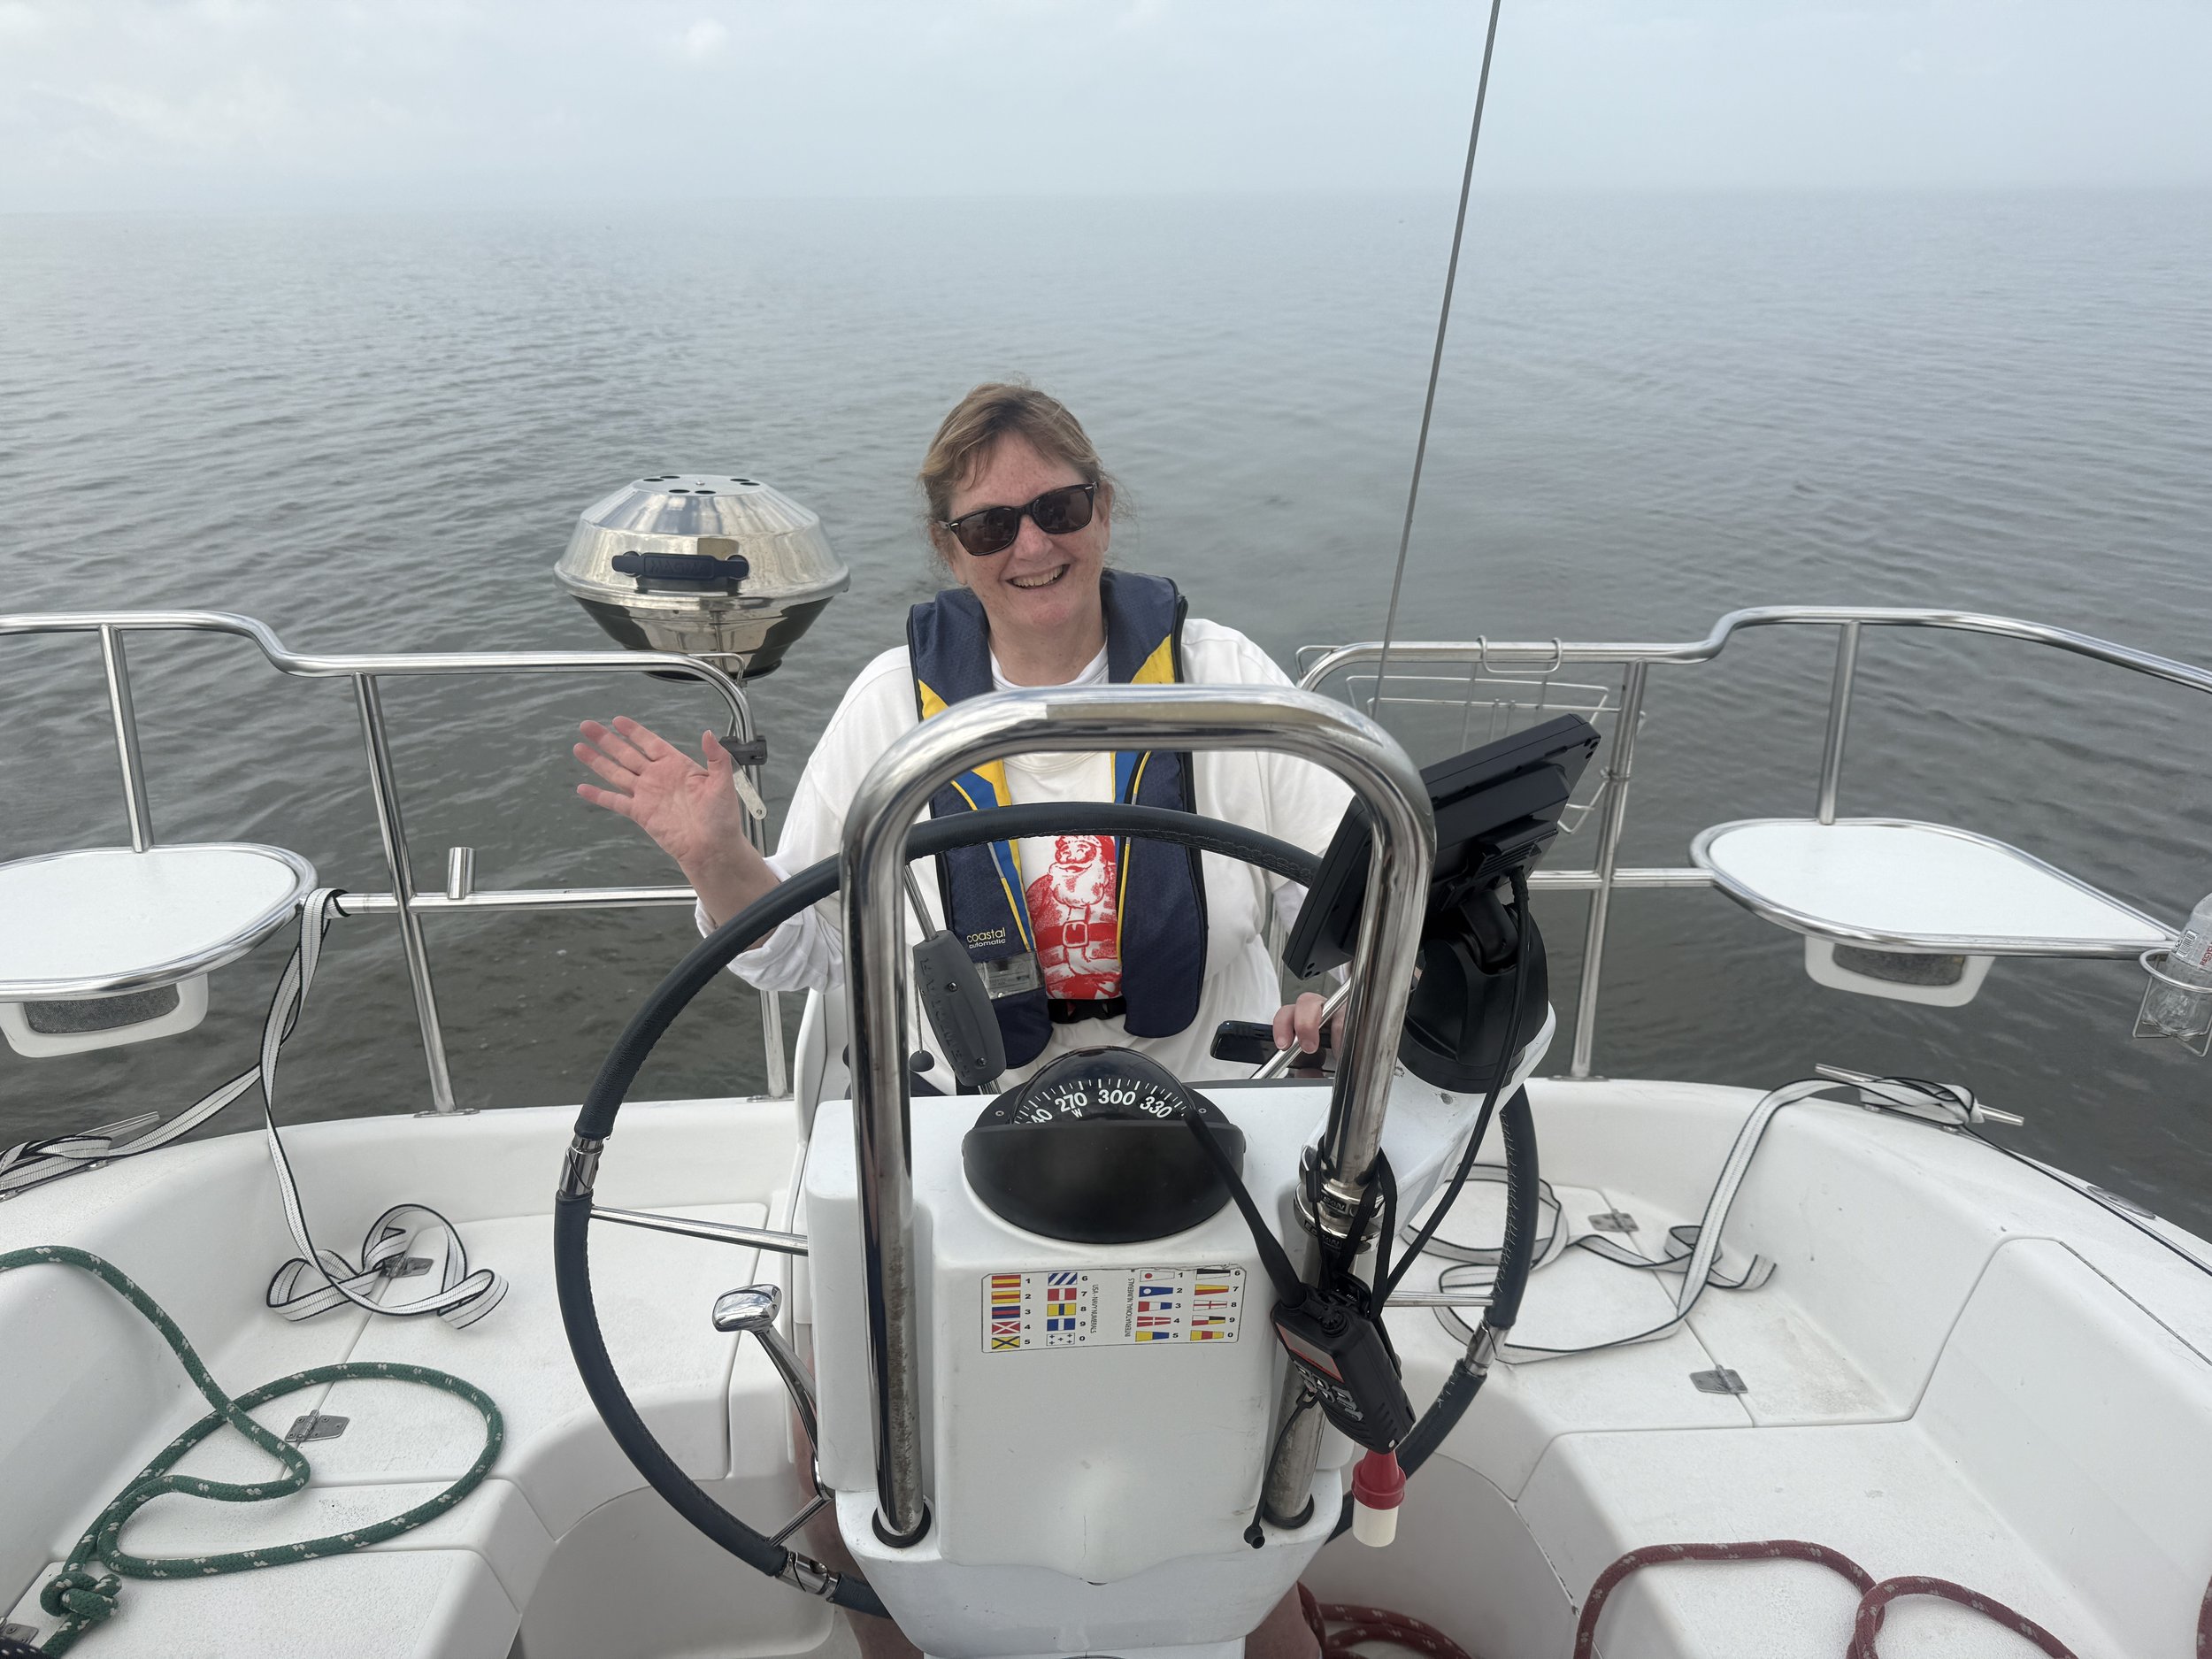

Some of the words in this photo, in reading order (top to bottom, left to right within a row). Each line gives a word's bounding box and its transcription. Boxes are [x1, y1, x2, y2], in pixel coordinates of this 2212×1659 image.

[966, 927, 1006, 943] coastal
[969, 938, 1006, 949] automatic
[1026, 1109, 1053, 1124] 40
[1055, 1092, 1087, 1112] 270
[1098, 1089, 1136, 1106] 300
[1140, 1101, 1172, 1118] 330
[1071, 1109, 1083, 1118] W
